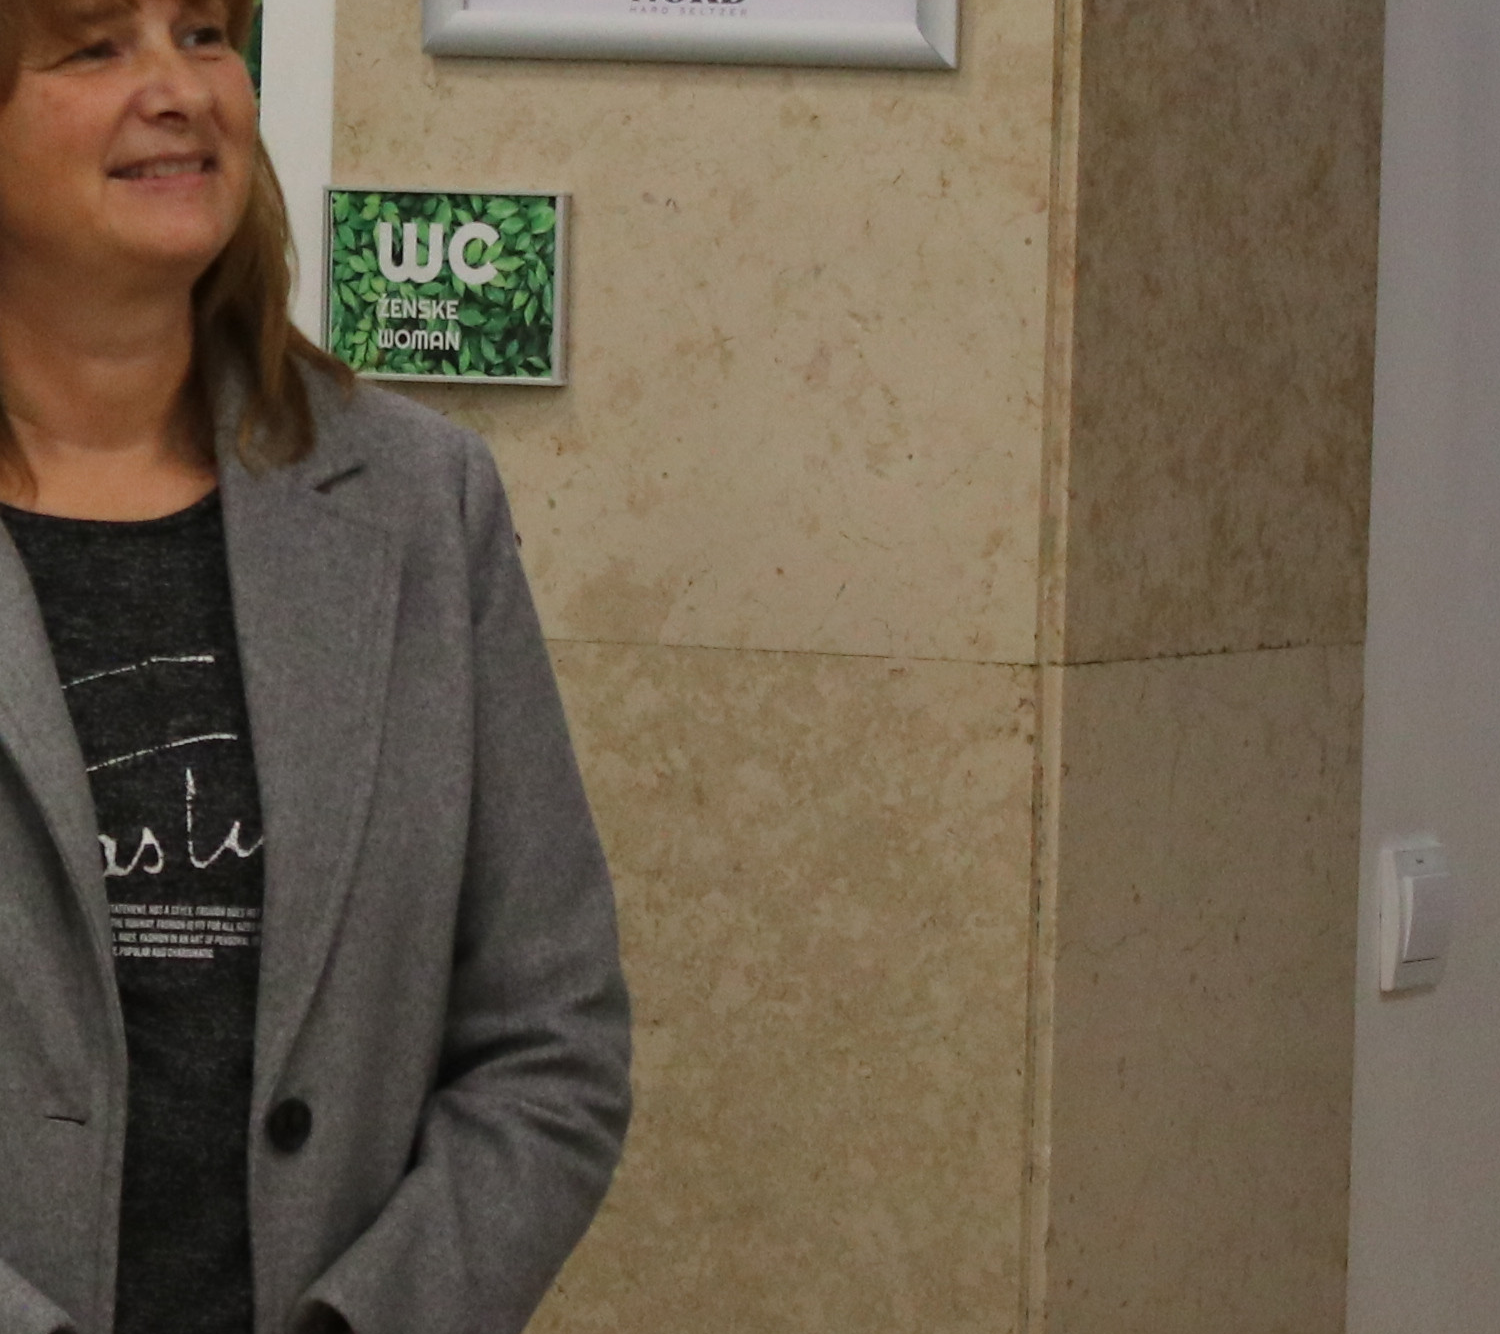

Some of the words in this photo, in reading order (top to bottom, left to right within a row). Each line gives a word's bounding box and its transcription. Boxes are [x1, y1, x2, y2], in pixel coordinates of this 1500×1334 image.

[629, 6, 669, 15] HARD
[680, 7, 748, 17] SELTZER
[378, 221, 500, 285] WC
[377, 293, 460, 320] ŽENSKE
[377, 329, 460, 351] WOMAN
